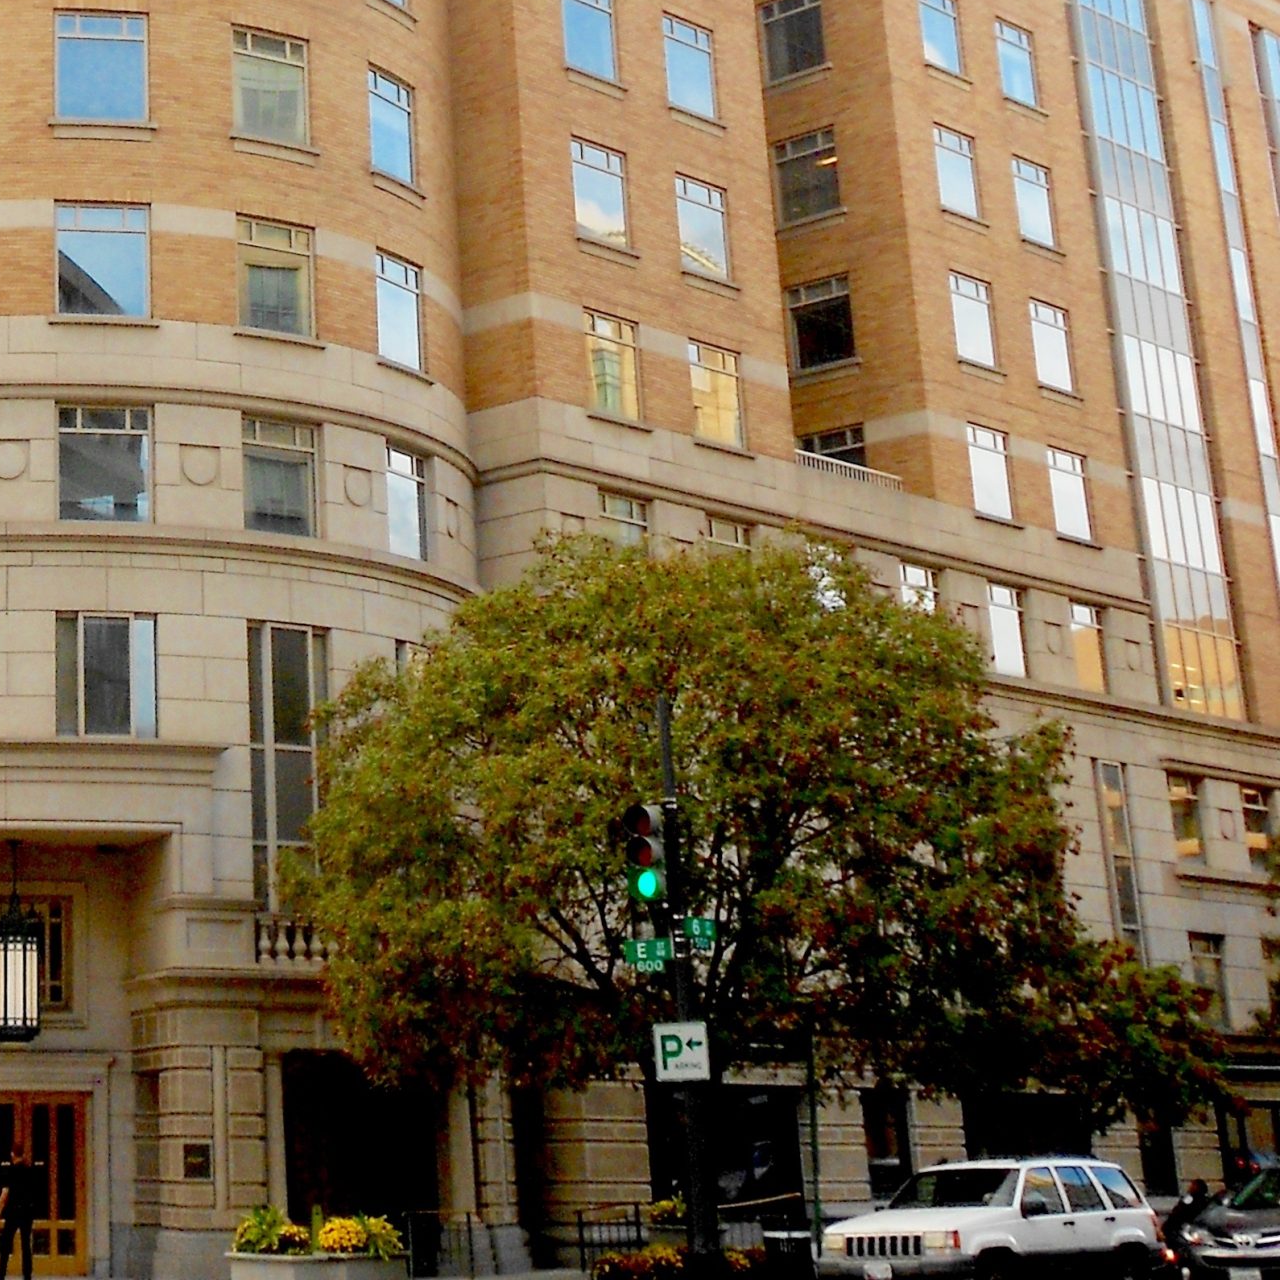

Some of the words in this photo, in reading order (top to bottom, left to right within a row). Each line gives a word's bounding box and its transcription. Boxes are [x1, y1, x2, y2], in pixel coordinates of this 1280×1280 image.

[692, 919, 701, 936] 6
[637, 942, 647, 958] E
[637, 960, 664, 972] 600
